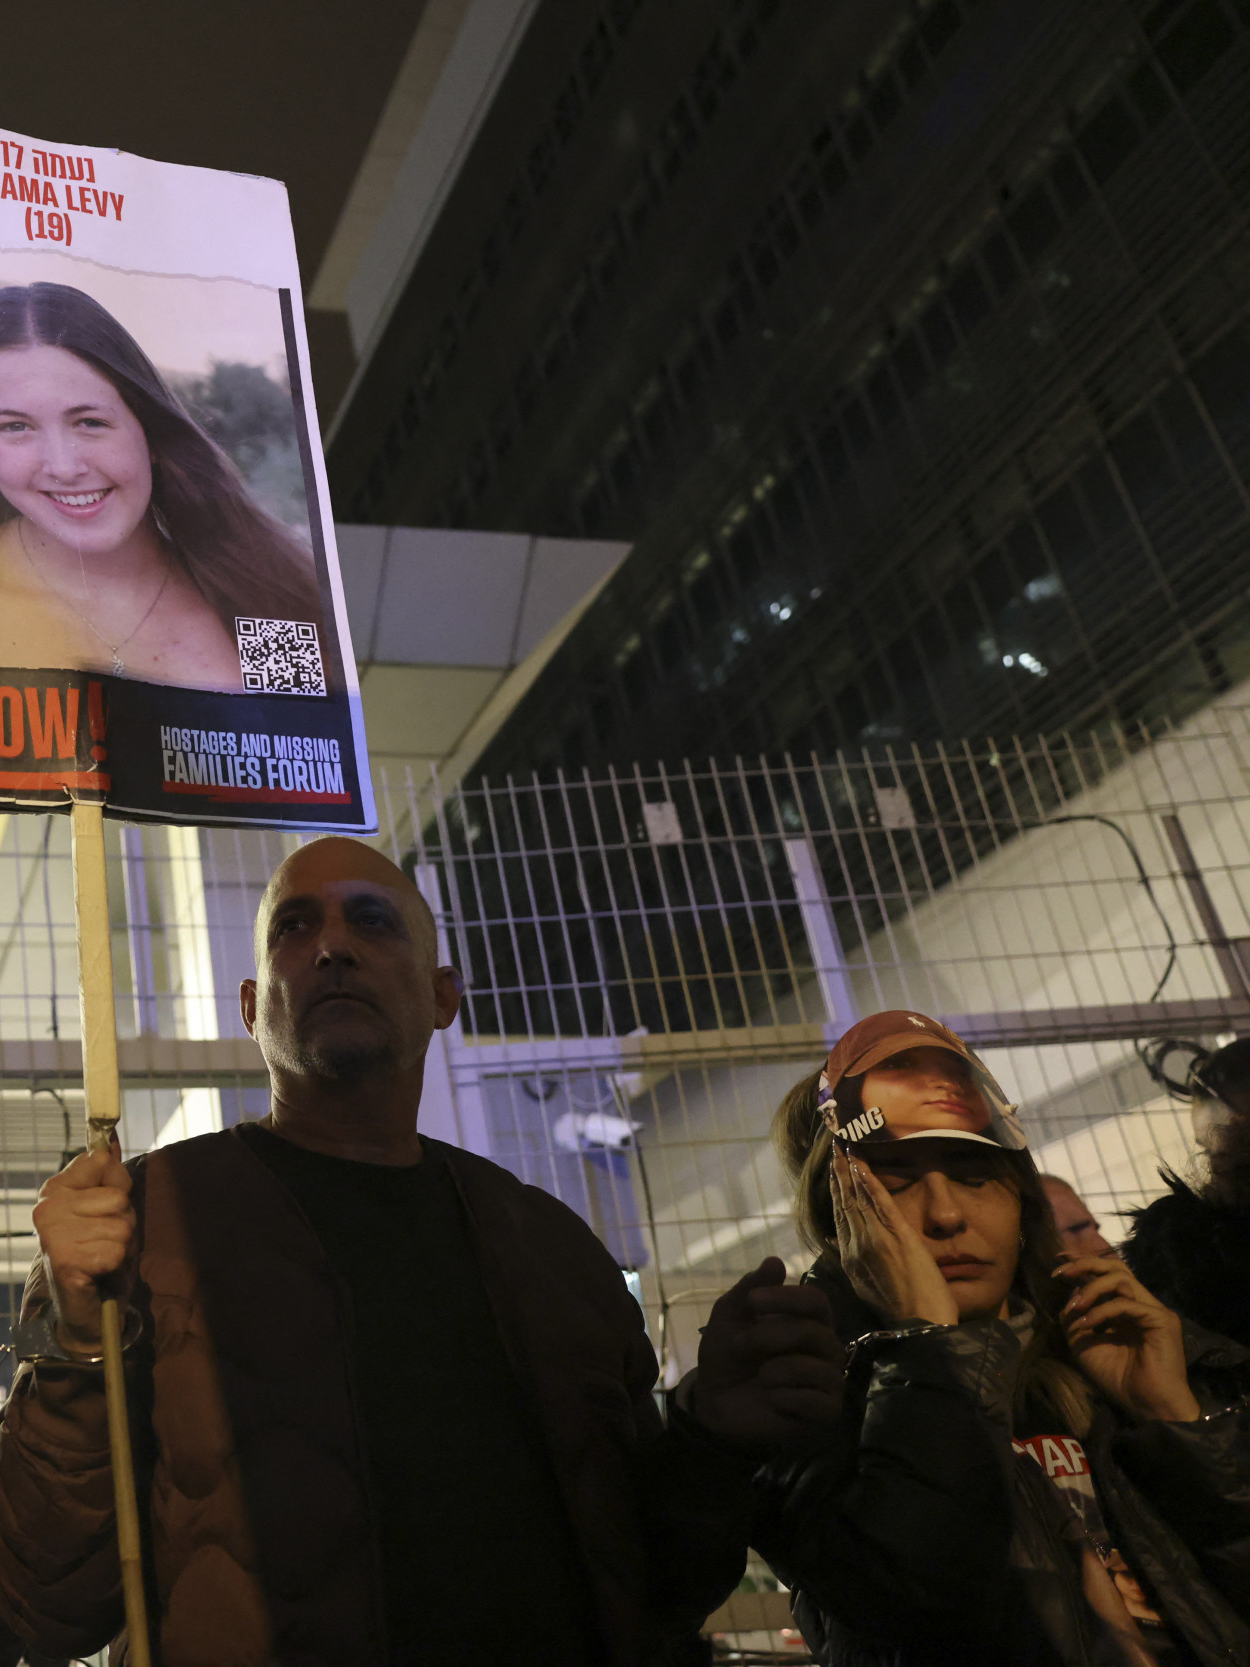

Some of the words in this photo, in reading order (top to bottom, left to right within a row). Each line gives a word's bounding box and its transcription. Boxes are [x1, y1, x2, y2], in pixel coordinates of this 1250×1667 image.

[32, 149, 96, 183] נעמה
[66, 185, 124, 221] LEVY
[24, 207, 73, 247] (19)
[160, 725, 238, 757] HOSTAGES
[240, 733, 272, 759] AND
[273, 735, 340, 763] MISSING
[162, 749, 262, 790] FAMILIES
[266, 758, 345, 795] FORUM
